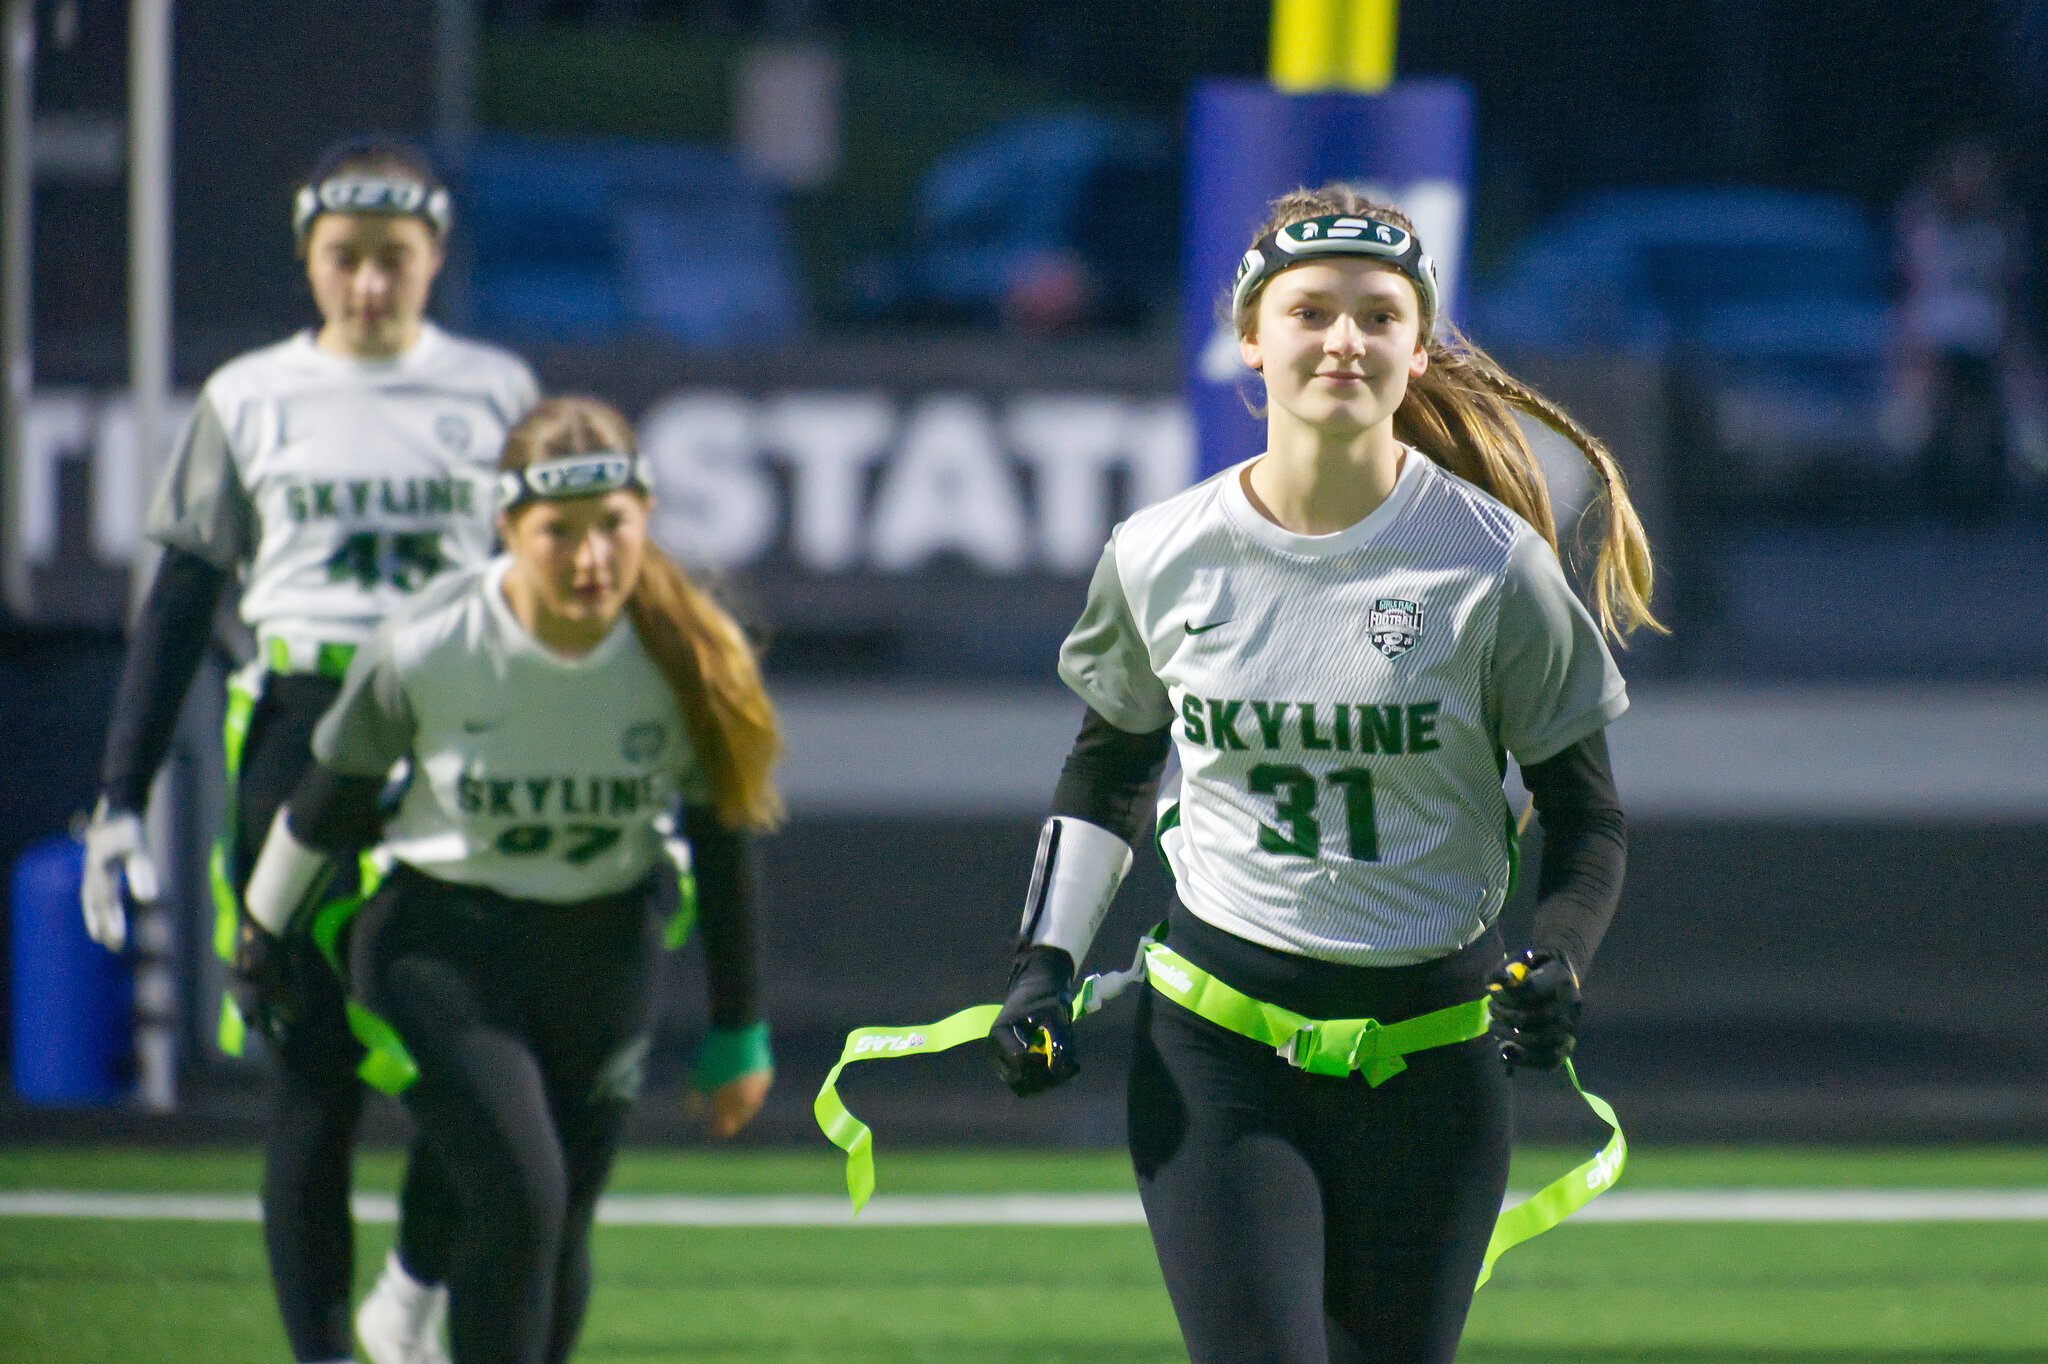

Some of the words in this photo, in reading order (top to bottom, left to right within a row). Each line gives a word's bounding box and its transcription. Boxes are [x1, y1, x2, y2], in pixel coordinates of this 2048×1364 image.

[1370, 610, 1419, 630] FOOTBALL
[1181, 693, 1441, 755] SKYLINE
[1247, 762, 1382, 863] 31
[854, 1034, 915, 1054] FLAG
